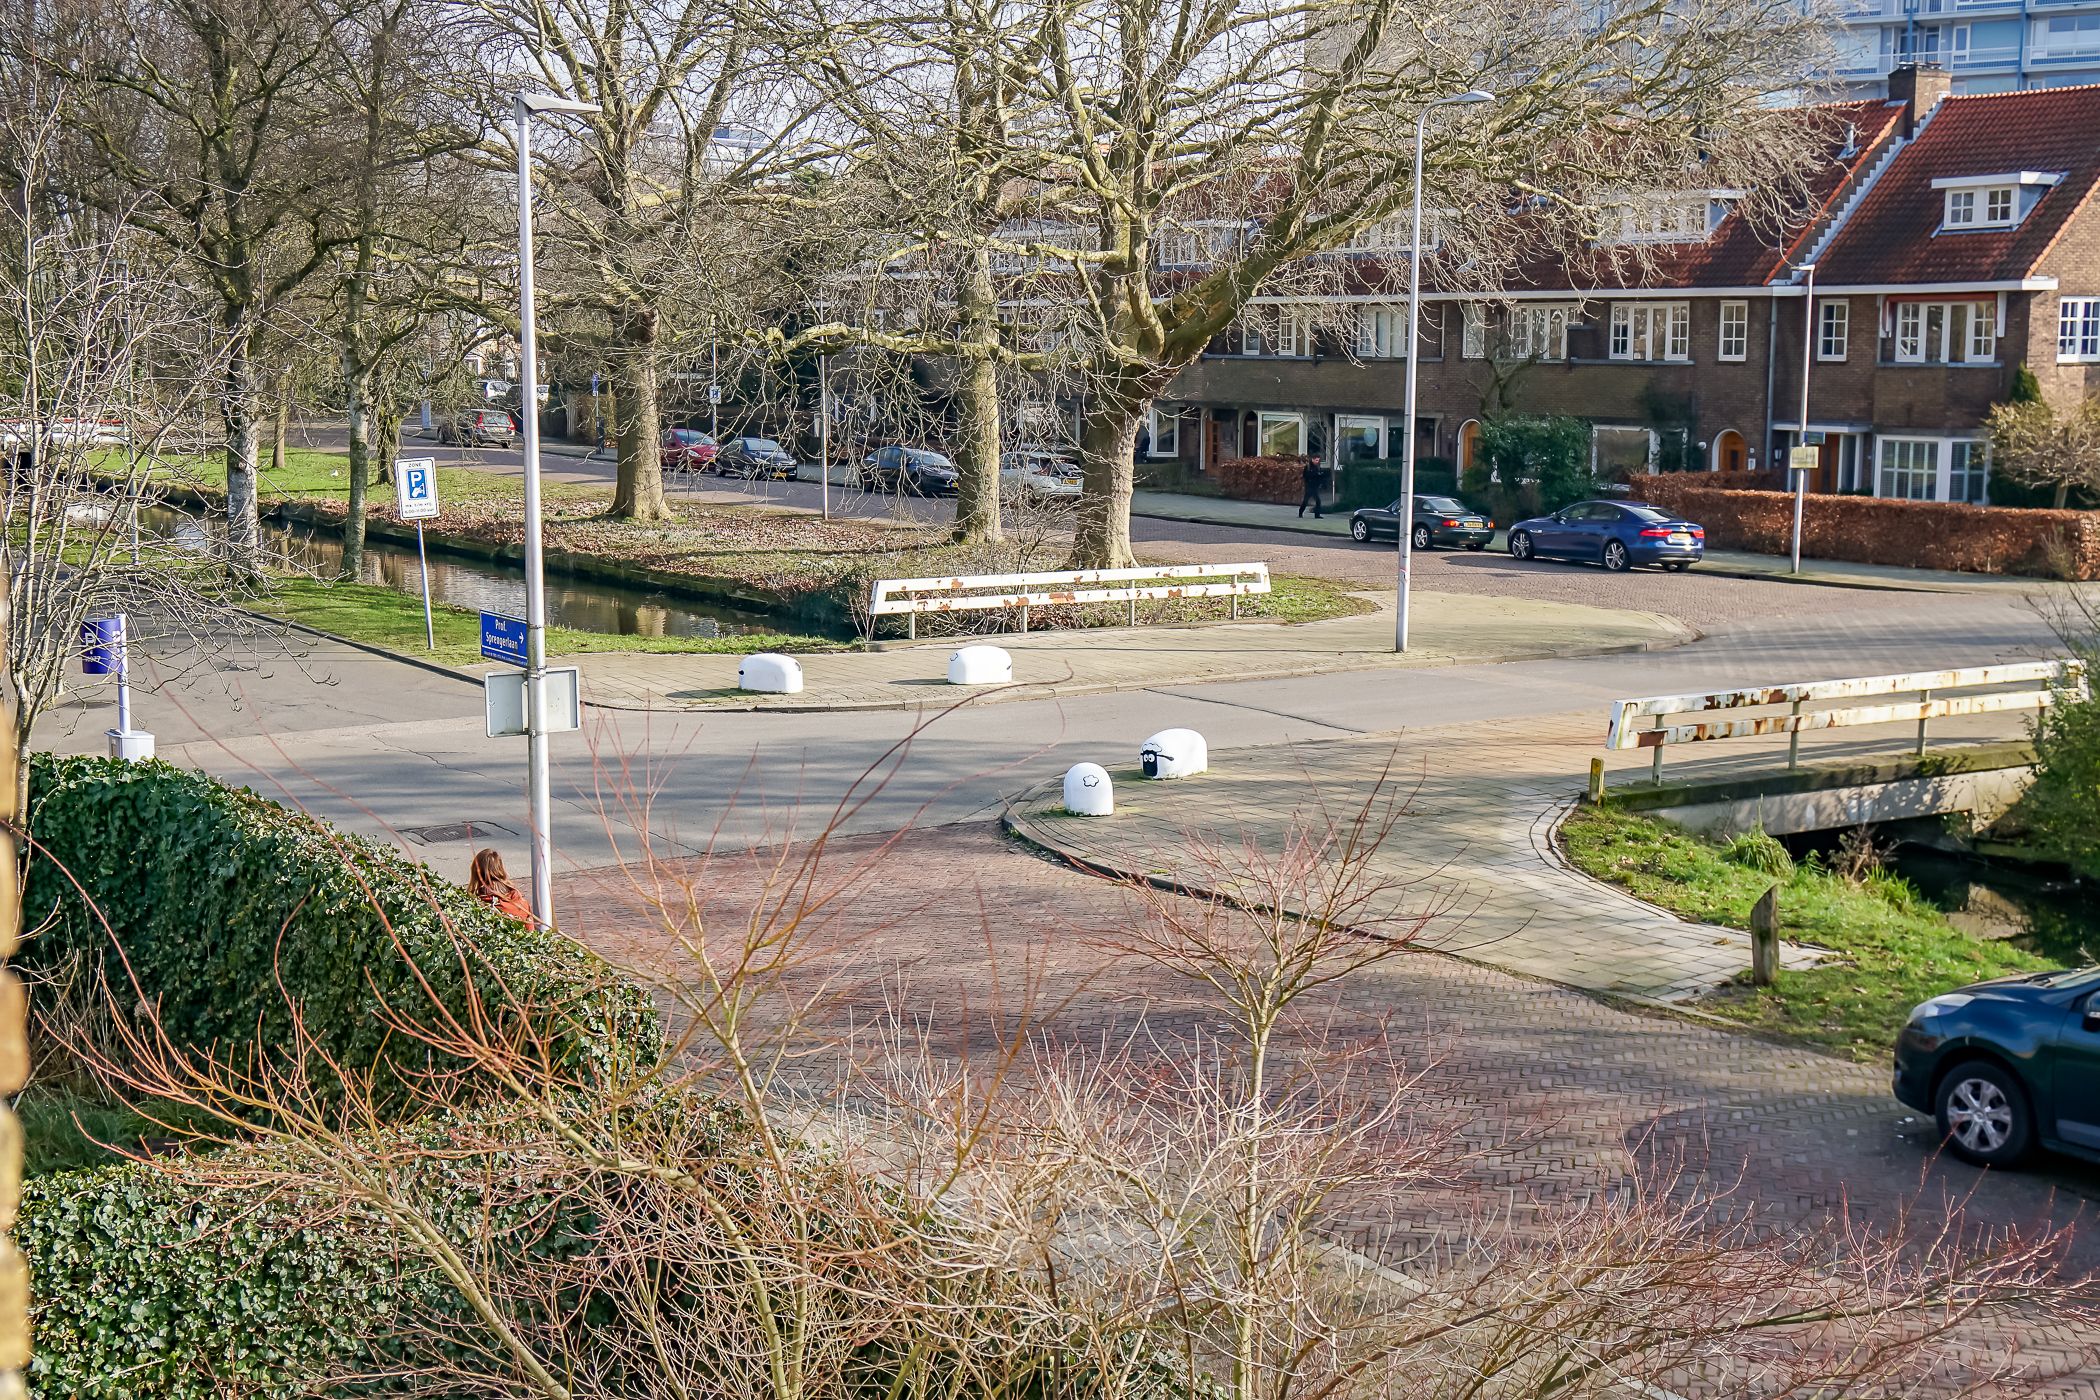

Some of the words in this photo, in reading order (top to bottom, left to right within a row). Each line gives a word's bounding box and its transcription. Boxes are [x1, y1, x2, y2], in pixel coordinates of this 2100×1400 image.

[410, 471, 422, 488] P
[495, 619, 507, 631] Prof.
[486, 632, 518, 649] Sprengerlaan
